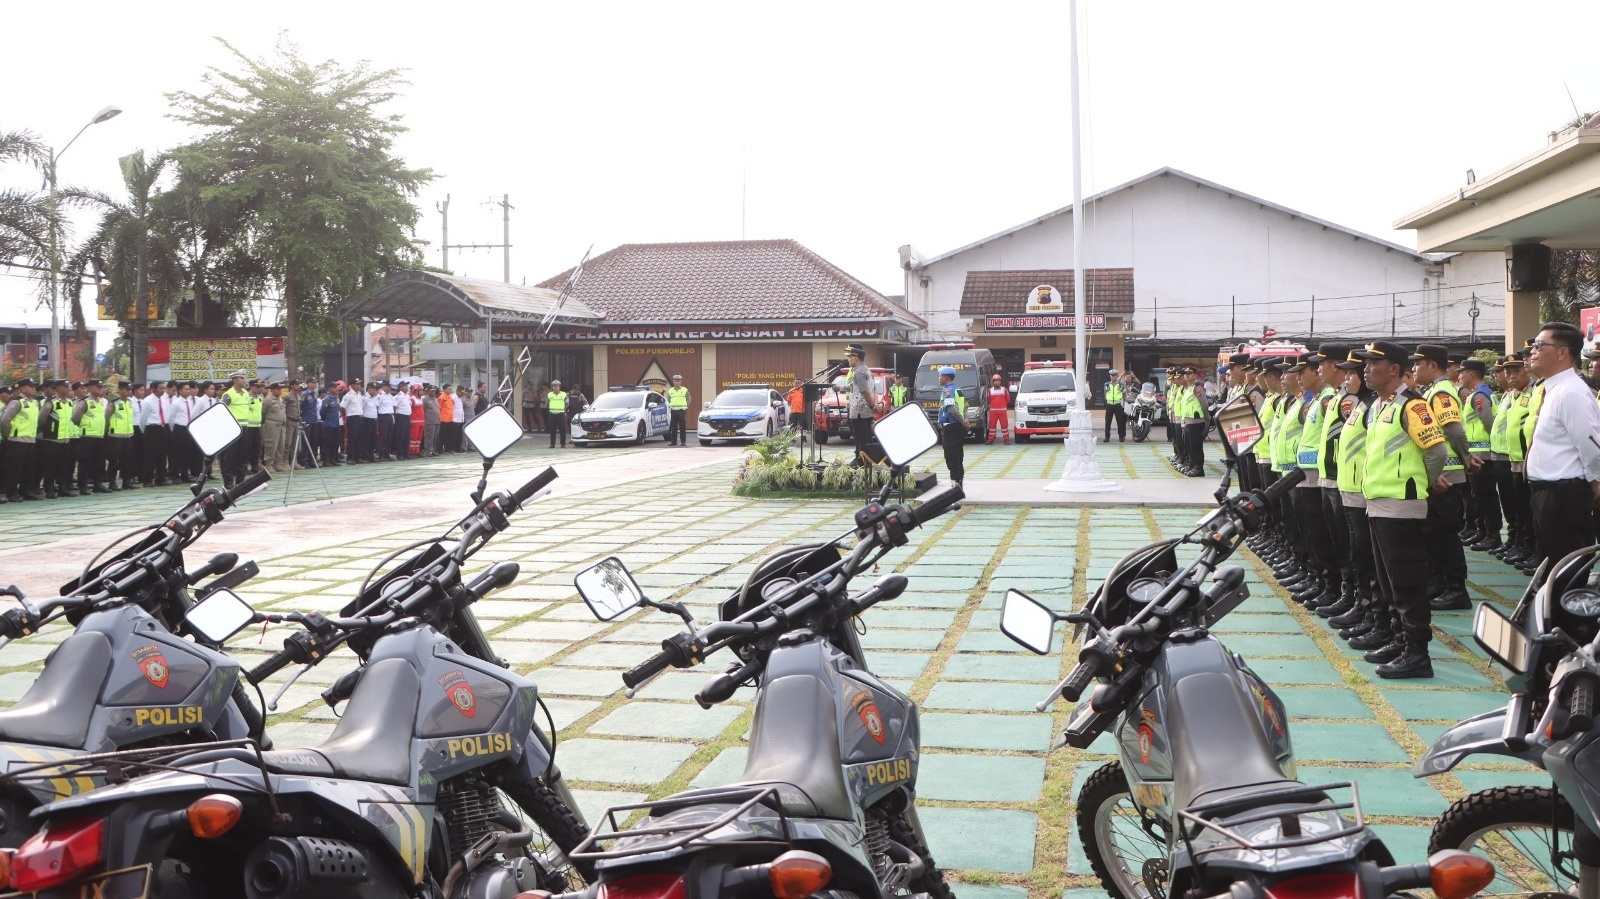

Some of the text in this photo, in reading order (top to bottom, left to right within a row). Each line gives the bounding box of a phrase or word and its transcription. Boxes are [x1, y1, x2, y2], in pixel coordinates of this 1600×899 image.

[675, 326, 785, 340] KEPOLISIAN
[792, 324, 877, 338] TERPADU
[171, 340, 257, 350] KERJA KERAS
[38, 346, 48, 360] P
[171, 351, 257, 360] KERJA CERDAS
[171, 361, 208, 370] KERJA
[171, 370, 208, 380] KERJA
[136, 706, 203, 727] POLISI
[447, 732, 512, 758] POLISI
[867, 758, 911, 785] POLISI
